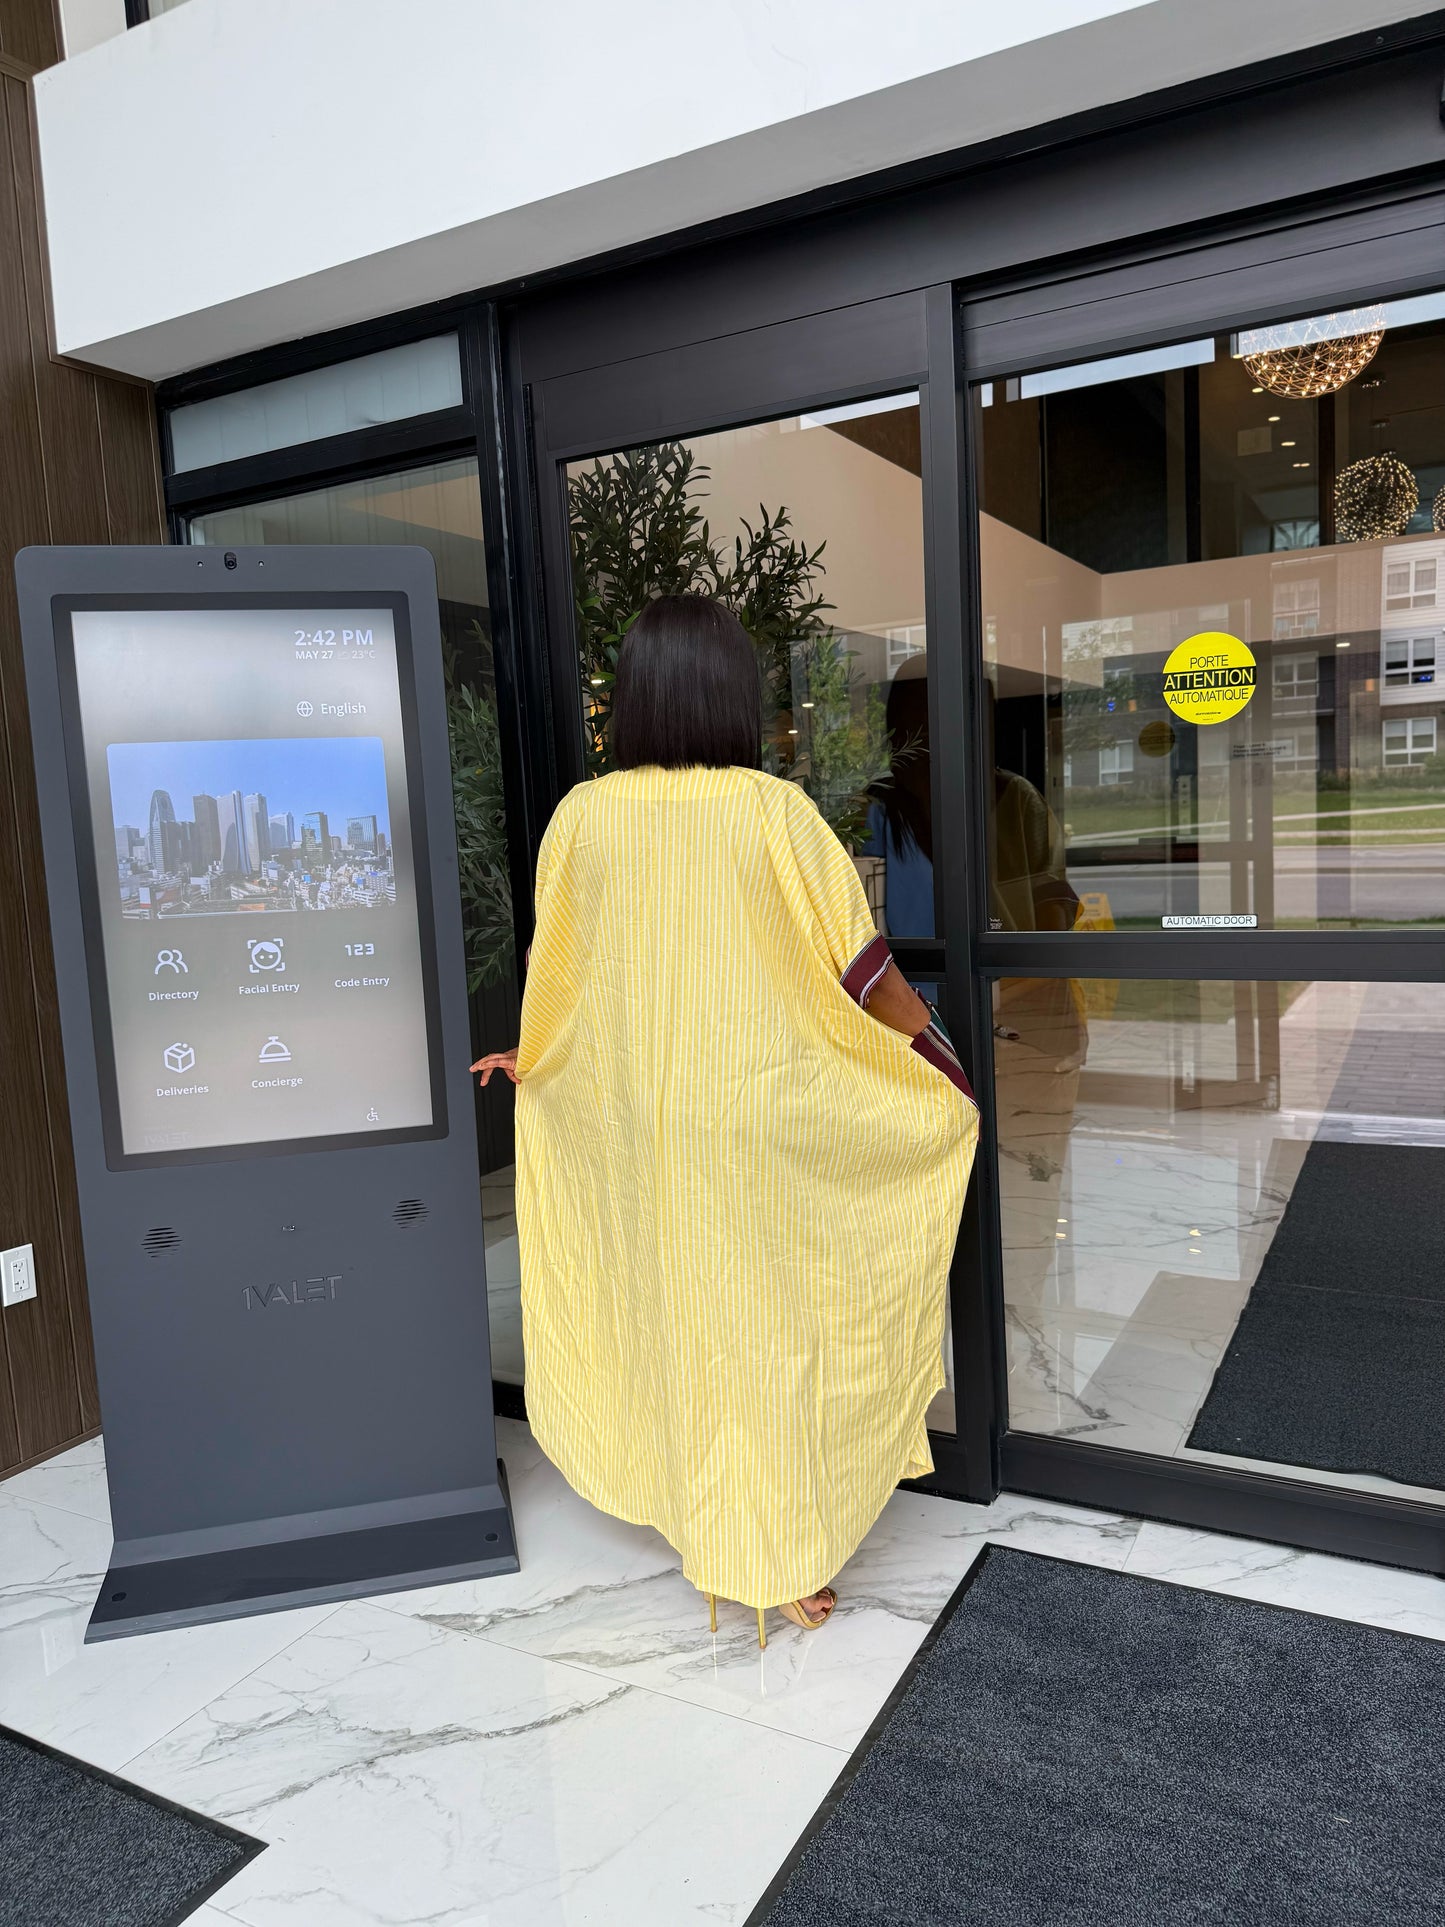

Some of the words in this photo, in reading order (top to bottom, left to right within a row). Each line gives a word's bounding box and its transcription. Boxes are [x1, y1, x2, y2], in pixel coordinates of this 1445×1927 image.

[294, 629, 337, 646] 2:42
[342, 629, 374, 646] PM
[295, 650, 319, 659] MAY
[321, 650, 334, 659] 27
[351, 649, 376, 659] 23°C
[1189, 654, 1229, 669] PORTE
[1163, 668, 1254, 691] ATTENTION
[1169, 688, 1249, 705] AUTOMATIQUE
[321, 702, 367, 717] English
[1166, 916, 1221, 926] AUTOMATIC
[1223, 916, 1253, 925] DOOR
[344, 943, 375, 957] 123
[238, 983, 270, 995] Facial
[272, 982, 301, 994] Entry
[334, 978, 361, 988] Code
[363, 976, 390, 987] Entry
[148, 989, 200, 1002] Directory
[251, 1076, 304, 1089] Concierge
[156, 1083, 210, 1098] Deliveries
